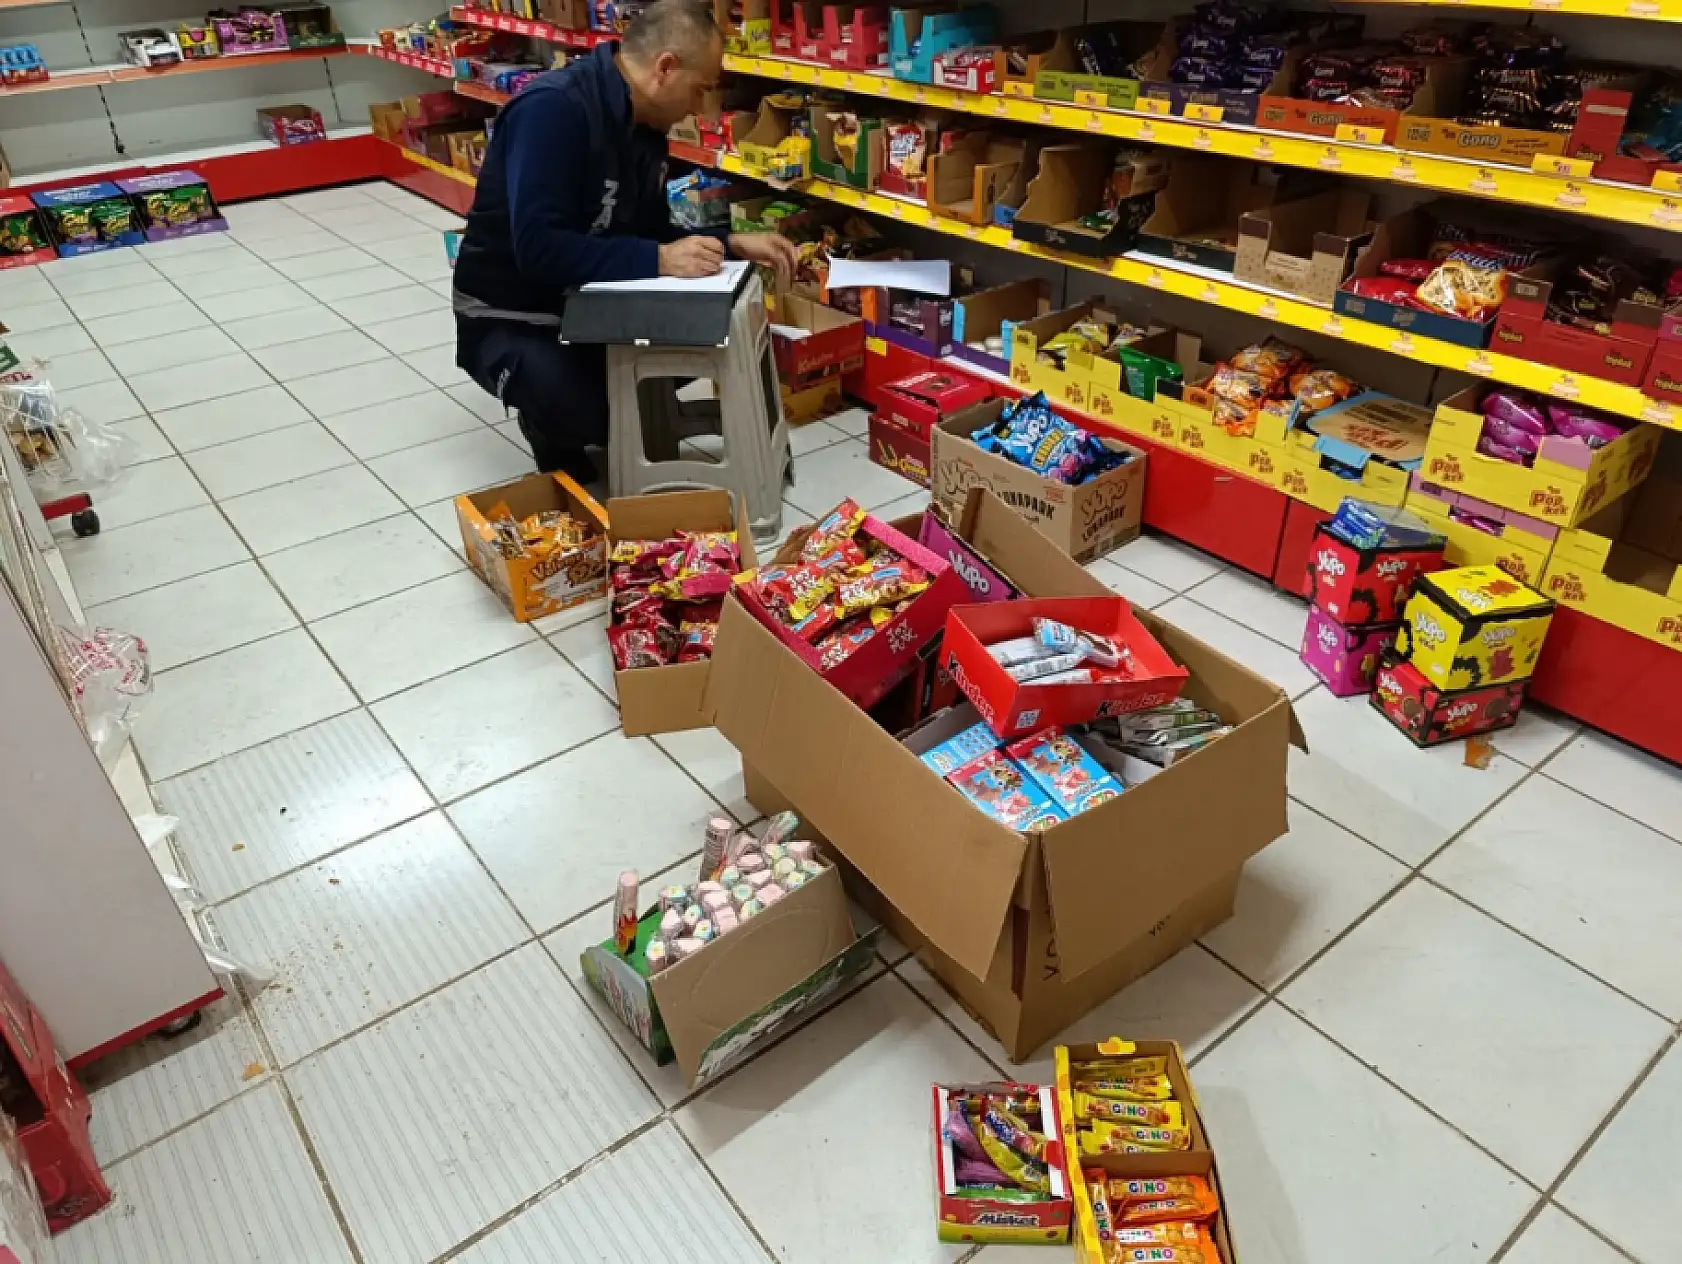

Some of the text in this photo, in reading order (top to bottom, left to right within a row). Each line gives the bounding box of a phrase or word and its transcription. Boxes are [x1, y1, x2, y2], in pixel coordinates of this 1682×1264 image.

[1458, 131, 1500, 149] Gong
[996, 490, 1056, 520] UNAPARK
[949, 549, 990, 593] Yupo
[1317, 550, 1345, 576] Yupo
